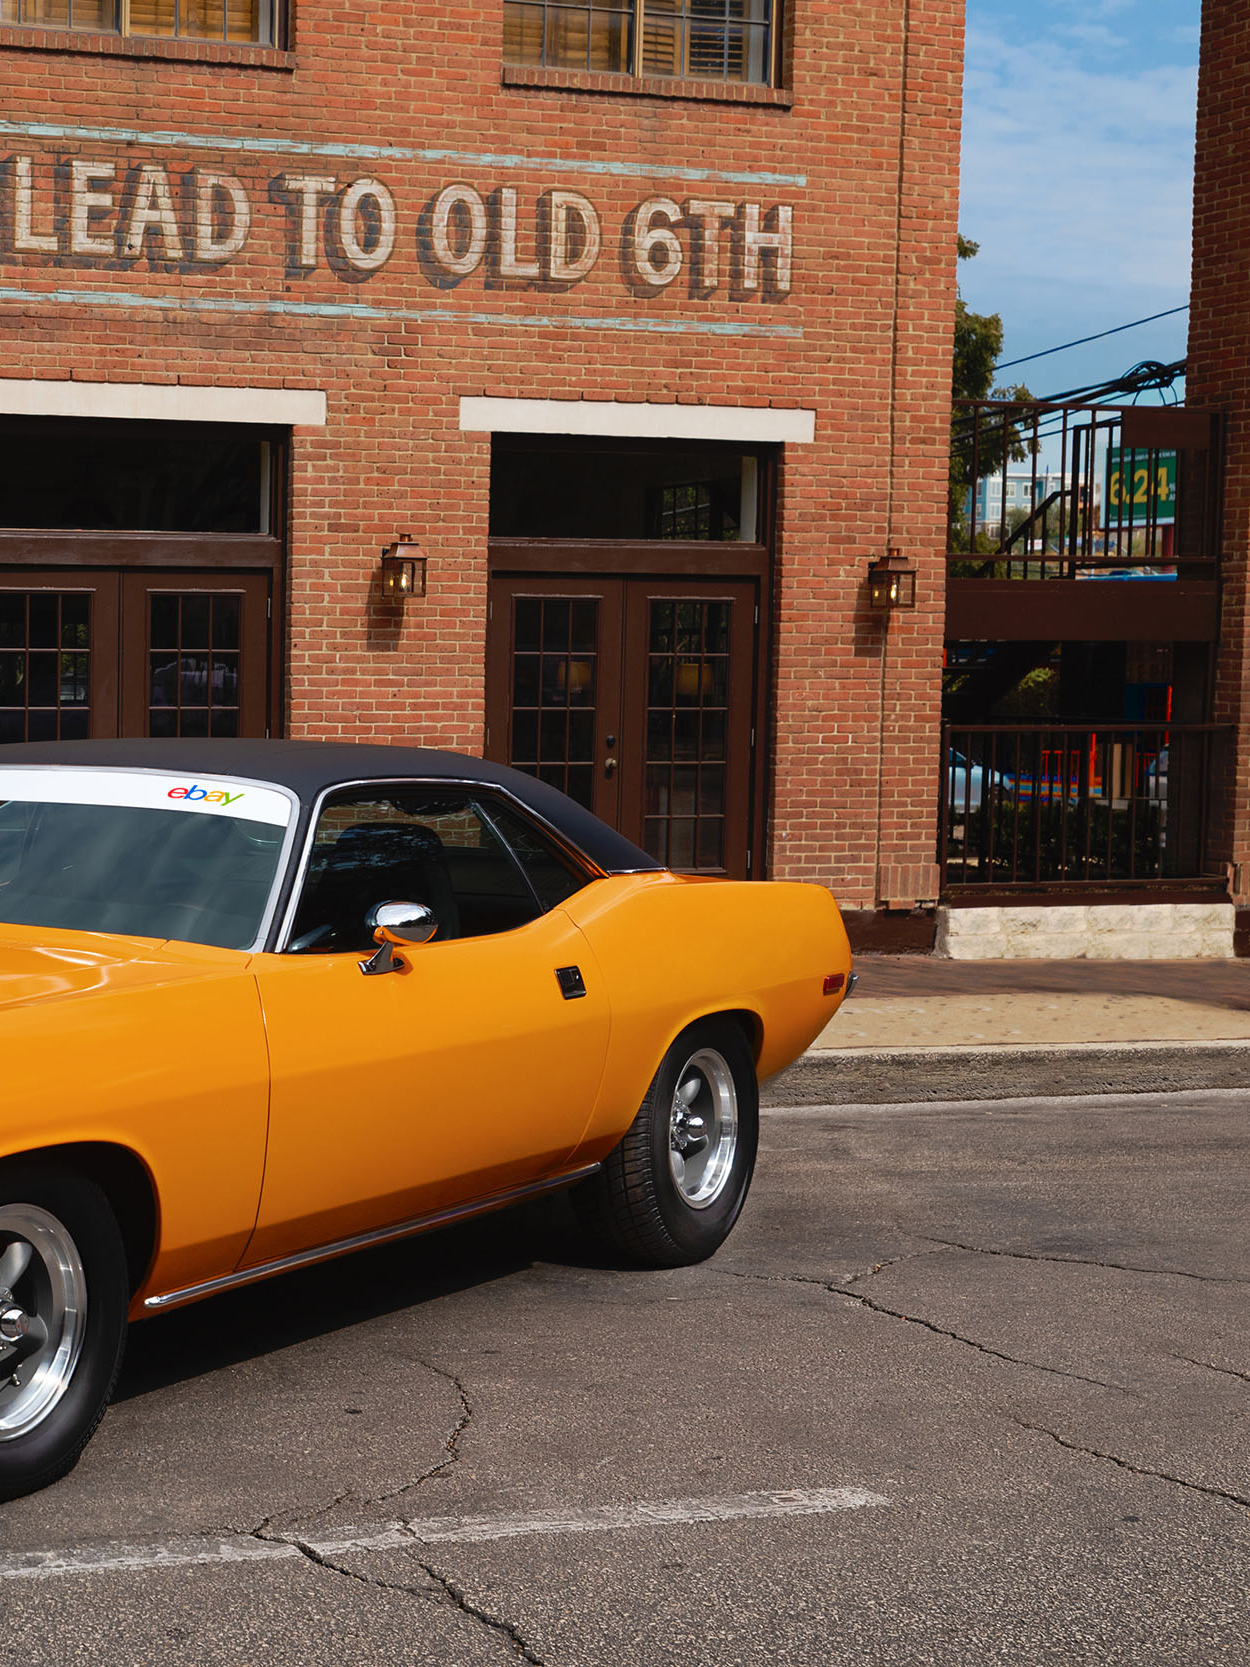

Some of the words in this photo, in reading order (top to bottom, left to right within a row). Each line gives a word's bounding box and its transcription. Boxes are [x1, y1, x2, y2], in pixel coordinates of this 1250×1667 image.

[10, 153, 248, 263] LEAD
[280, 173, 398, 272] TO
[429, 181, 603, 282] OLD
[631, 196, 794, 292] 6TH
[168, 785, 245, 806] ebay
